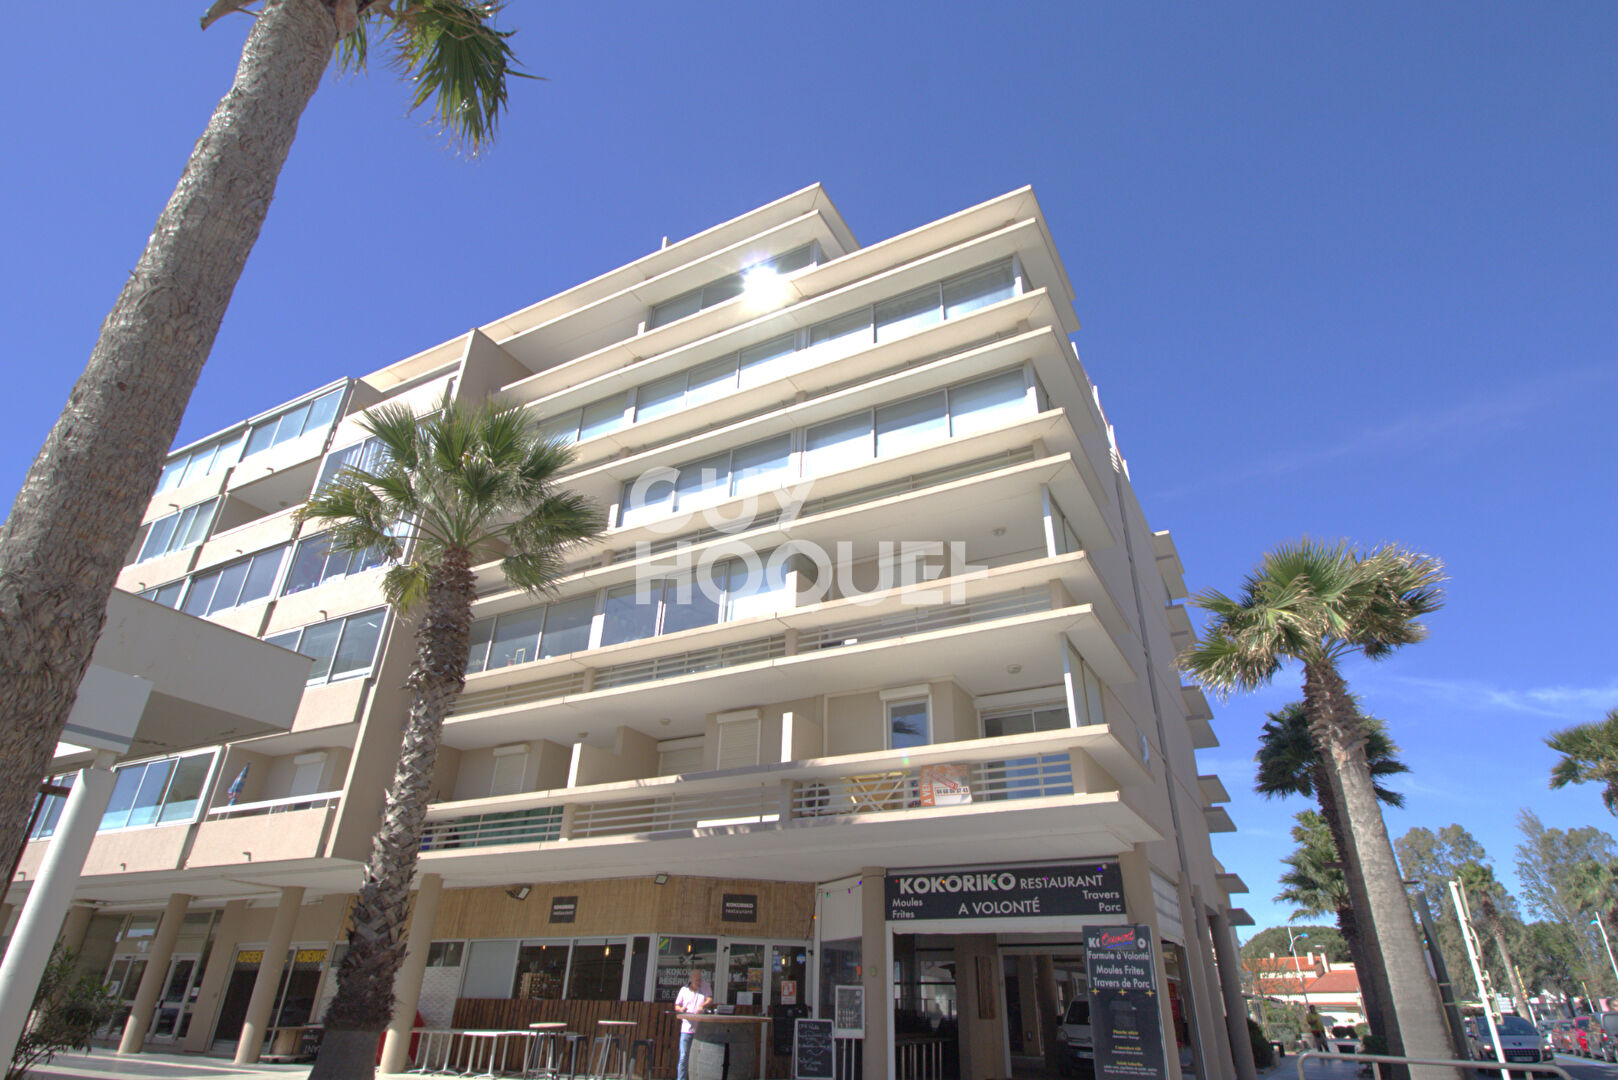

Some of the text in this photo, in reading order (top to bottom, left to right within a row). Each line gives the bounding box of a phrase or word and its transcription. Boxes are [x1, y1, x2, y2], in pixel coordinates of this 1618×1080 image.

[900, 872, 1103, 895] KOKORIKO RESTAURANT
[1082, 890, 1120, 900] Travers
[892, 898, 923, 907] Moules
[958, 896, 1040, 915] A VOLONTÉ
[1099, 902, 1122, 912] Porc
[892, 910, 915, 919] Frites
[1088, 951, 1115, 960] Formule
[1123, 951, 1149, 960] Volonté
[1096, 964, 1145, 975] Moules Frites
[1092, 976, 1150, 989] Travers de Porc
